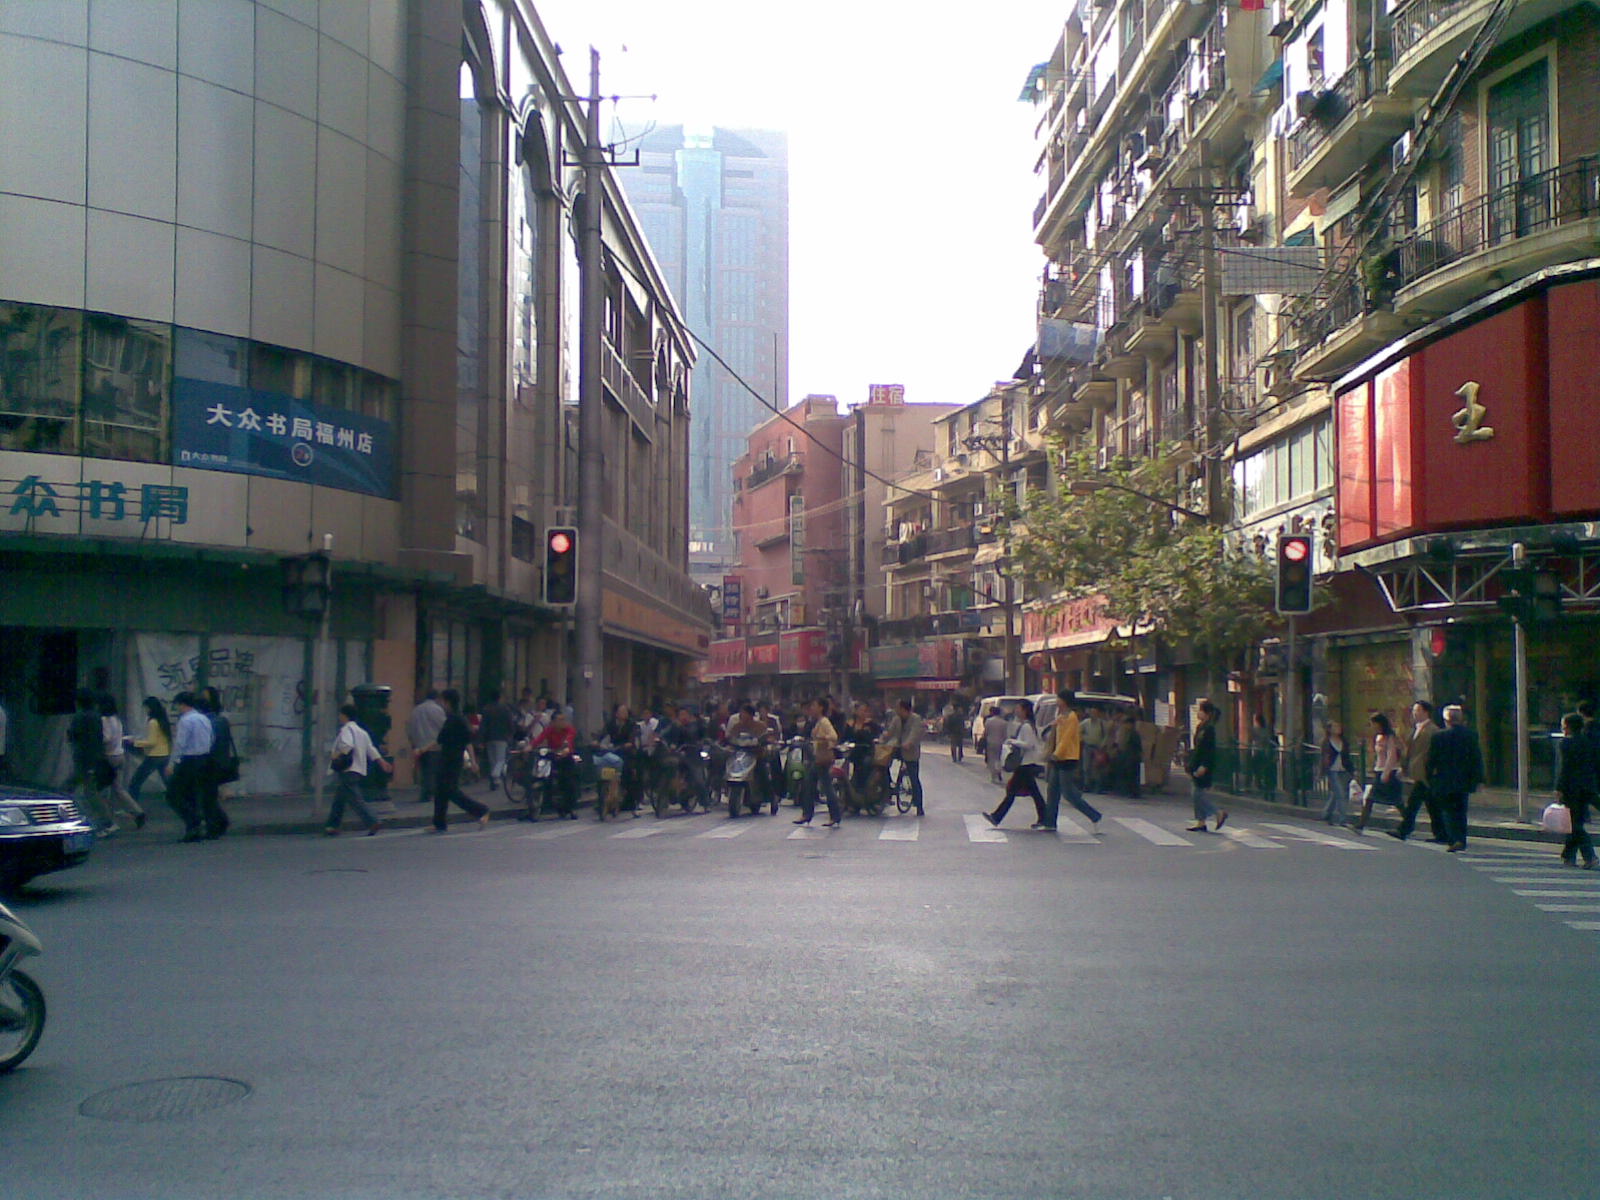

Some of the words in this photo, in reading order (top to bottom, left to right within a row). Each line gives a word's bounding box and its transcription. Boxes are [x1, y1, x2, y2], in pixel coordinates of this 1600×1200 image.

[205, 403, 374, 454] 大众书局福州店
[9, 475, 189, 525] 众书局
